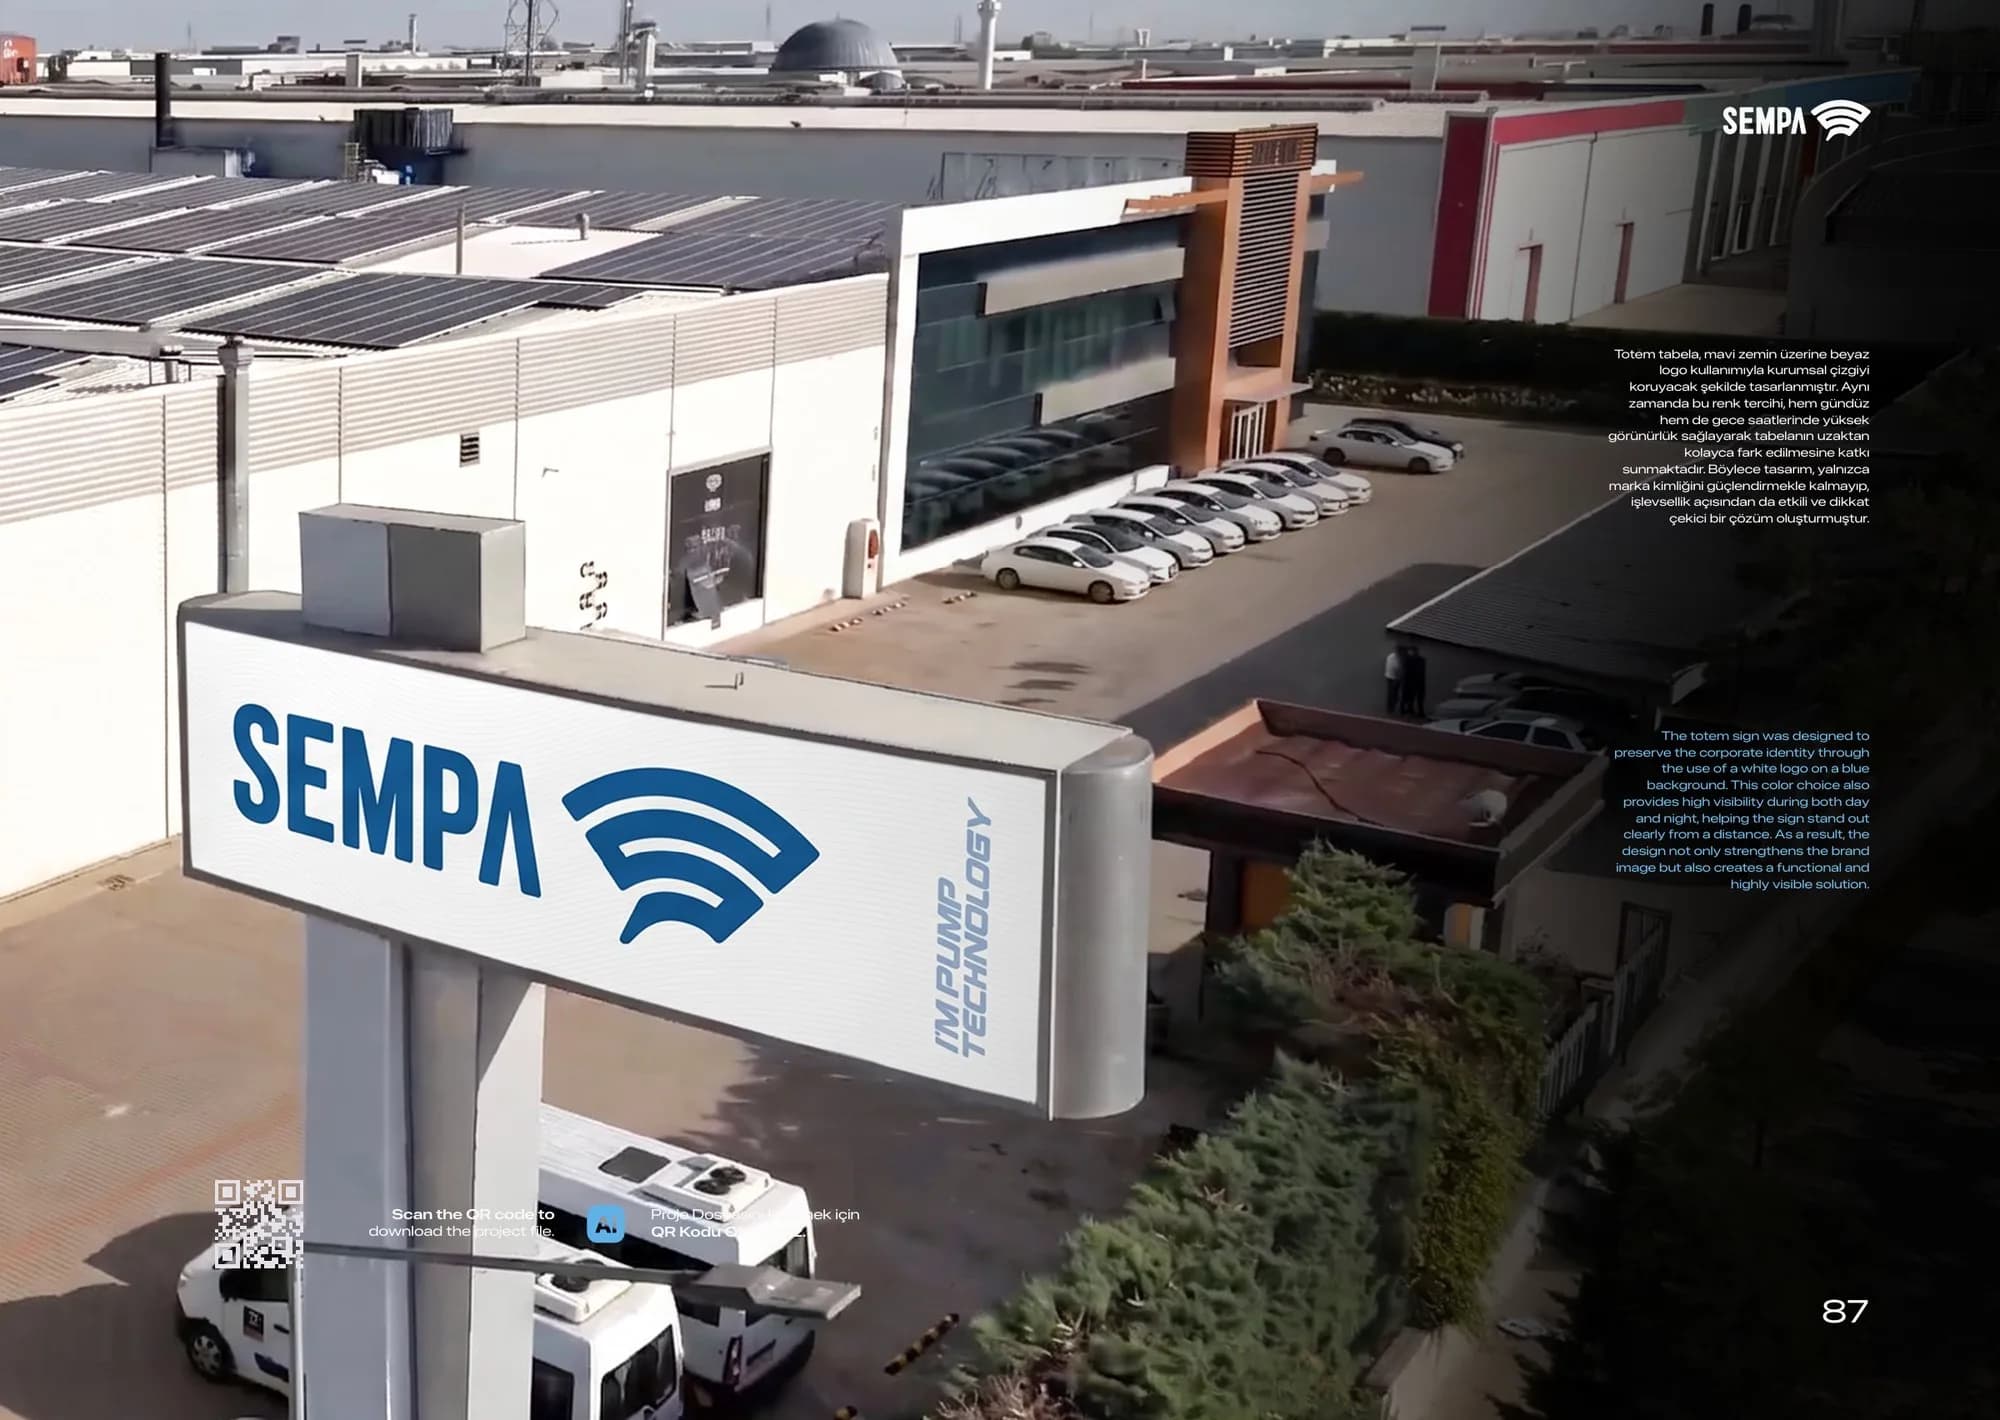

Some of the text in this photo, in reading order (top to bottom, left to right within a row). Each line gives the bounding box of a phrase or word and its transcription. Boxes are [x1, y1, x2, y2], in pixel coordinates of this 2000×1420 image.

[233, 702, 541, 898] SEMPA
[936, 877, 962, 998] PUMP
[962, 797, 992, 1058] TECHNOLOGY
